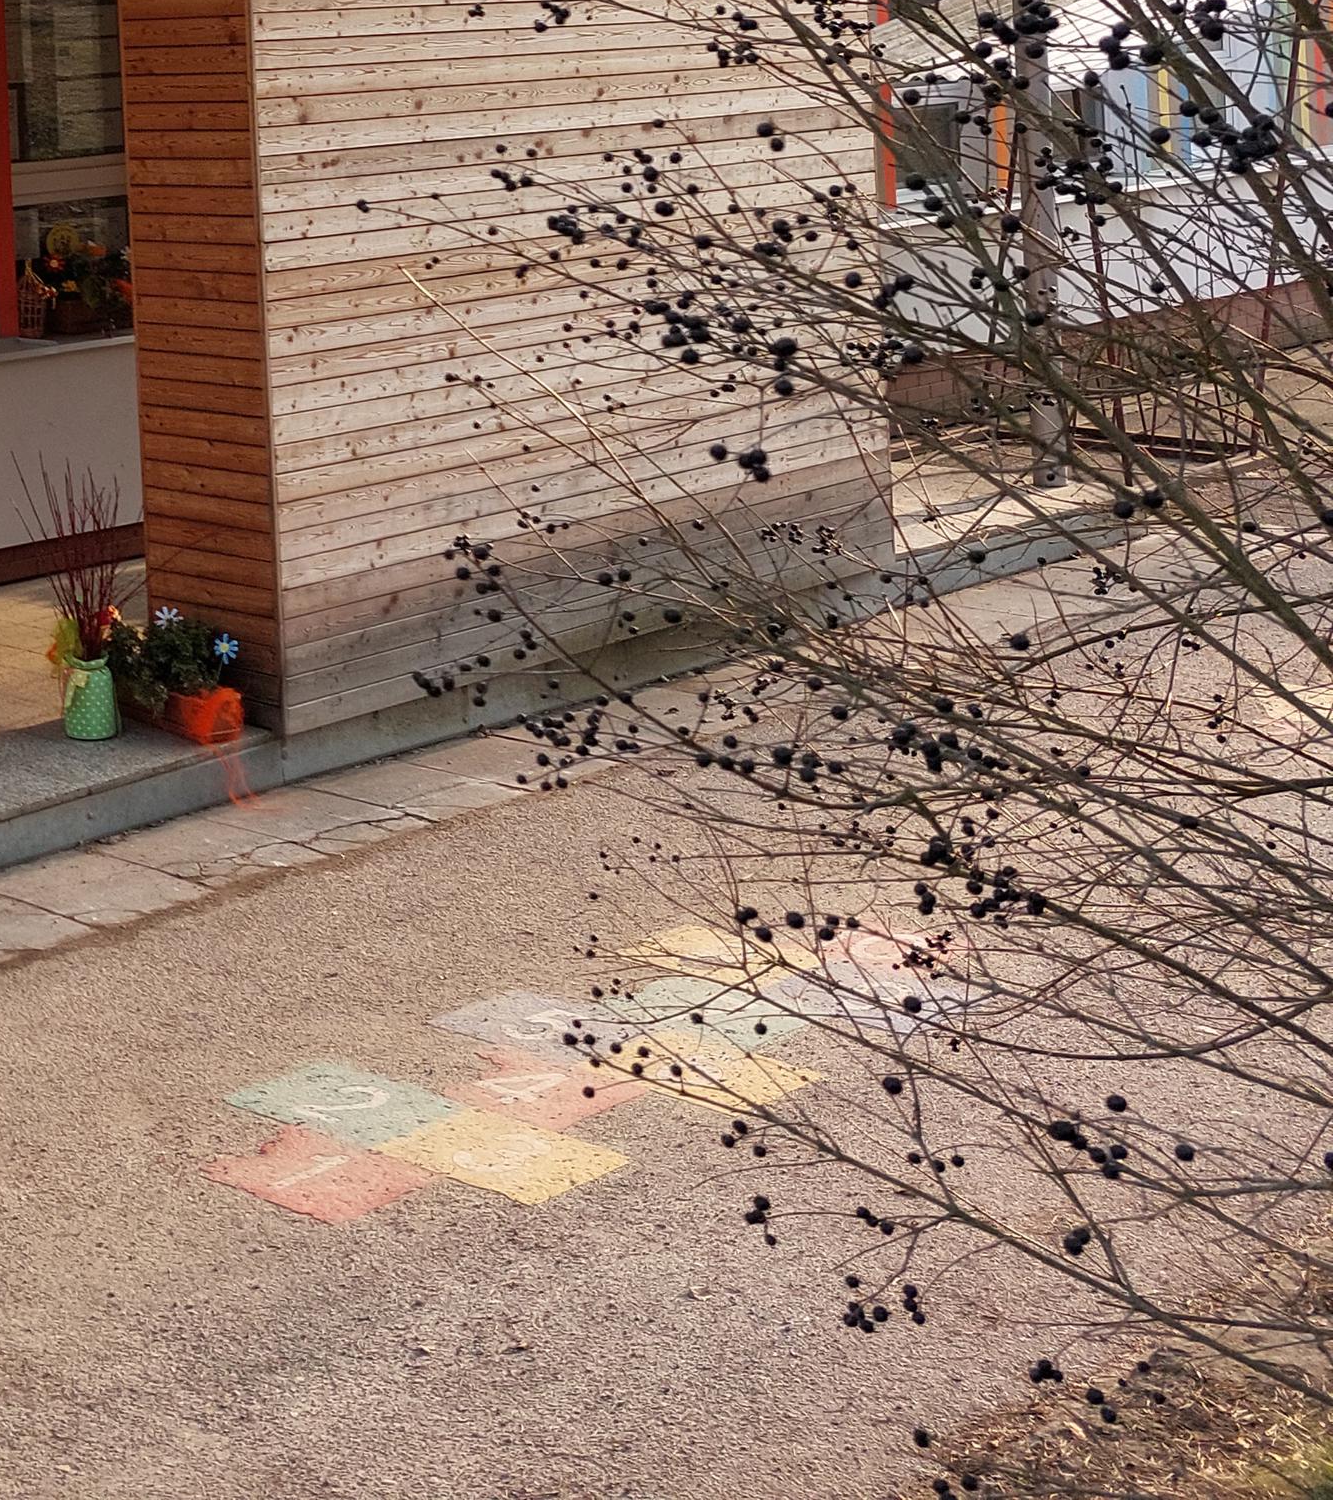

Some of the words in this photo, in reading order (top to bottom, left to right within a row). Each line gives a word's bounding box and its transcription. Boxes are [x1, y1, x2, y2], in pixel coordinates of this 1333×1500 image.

[290, 1083, 392, 1127] 2
[477, 1072, 571, 1105] 4
[269, 1153, 352, 1190] 1
[451, 1132, 553, 1173] 3
